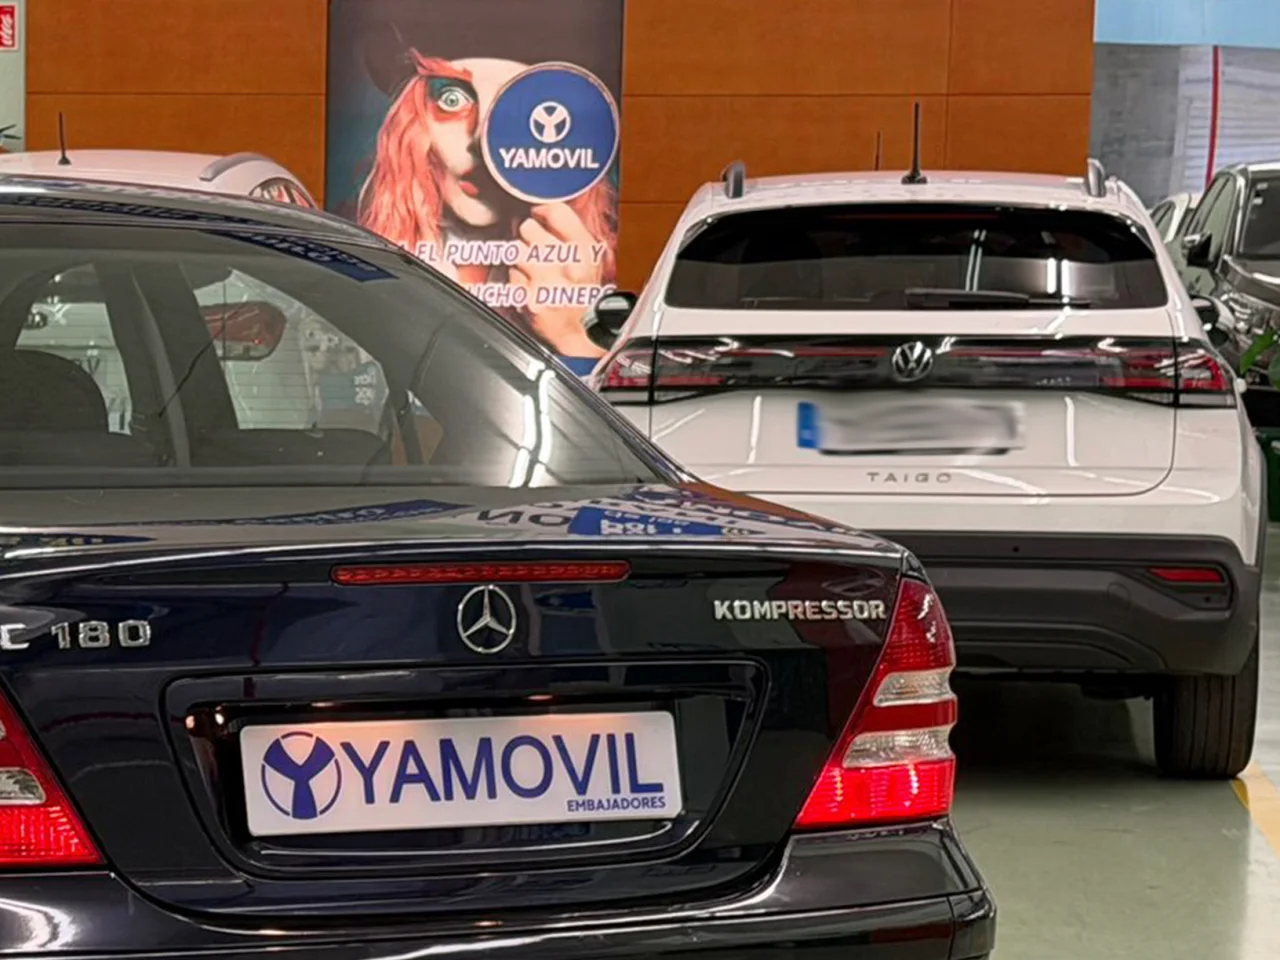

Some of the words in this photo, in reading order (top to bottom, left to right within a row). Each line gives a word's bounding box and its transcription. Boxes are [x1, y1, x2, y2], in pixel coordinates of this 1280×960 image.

[498, 147, 600, 169] YAMOVIL
[446, 243, 520, 263] PUNTO
[526, 243, 582, 263] AZUL
[591, 243, 605, 263] Y
[468, 285, 528, 304] UCHO
[866, 472, 953, 484] TAIGO
[713, 599, 887, 620] KOMPRESSOR
[0, 622, 31, 650] C
[50, 619, 152, 650] 180
[339, 731, 665, 805] YAMOVIL
[566, 795, 667, 813] EMBAJADORES
